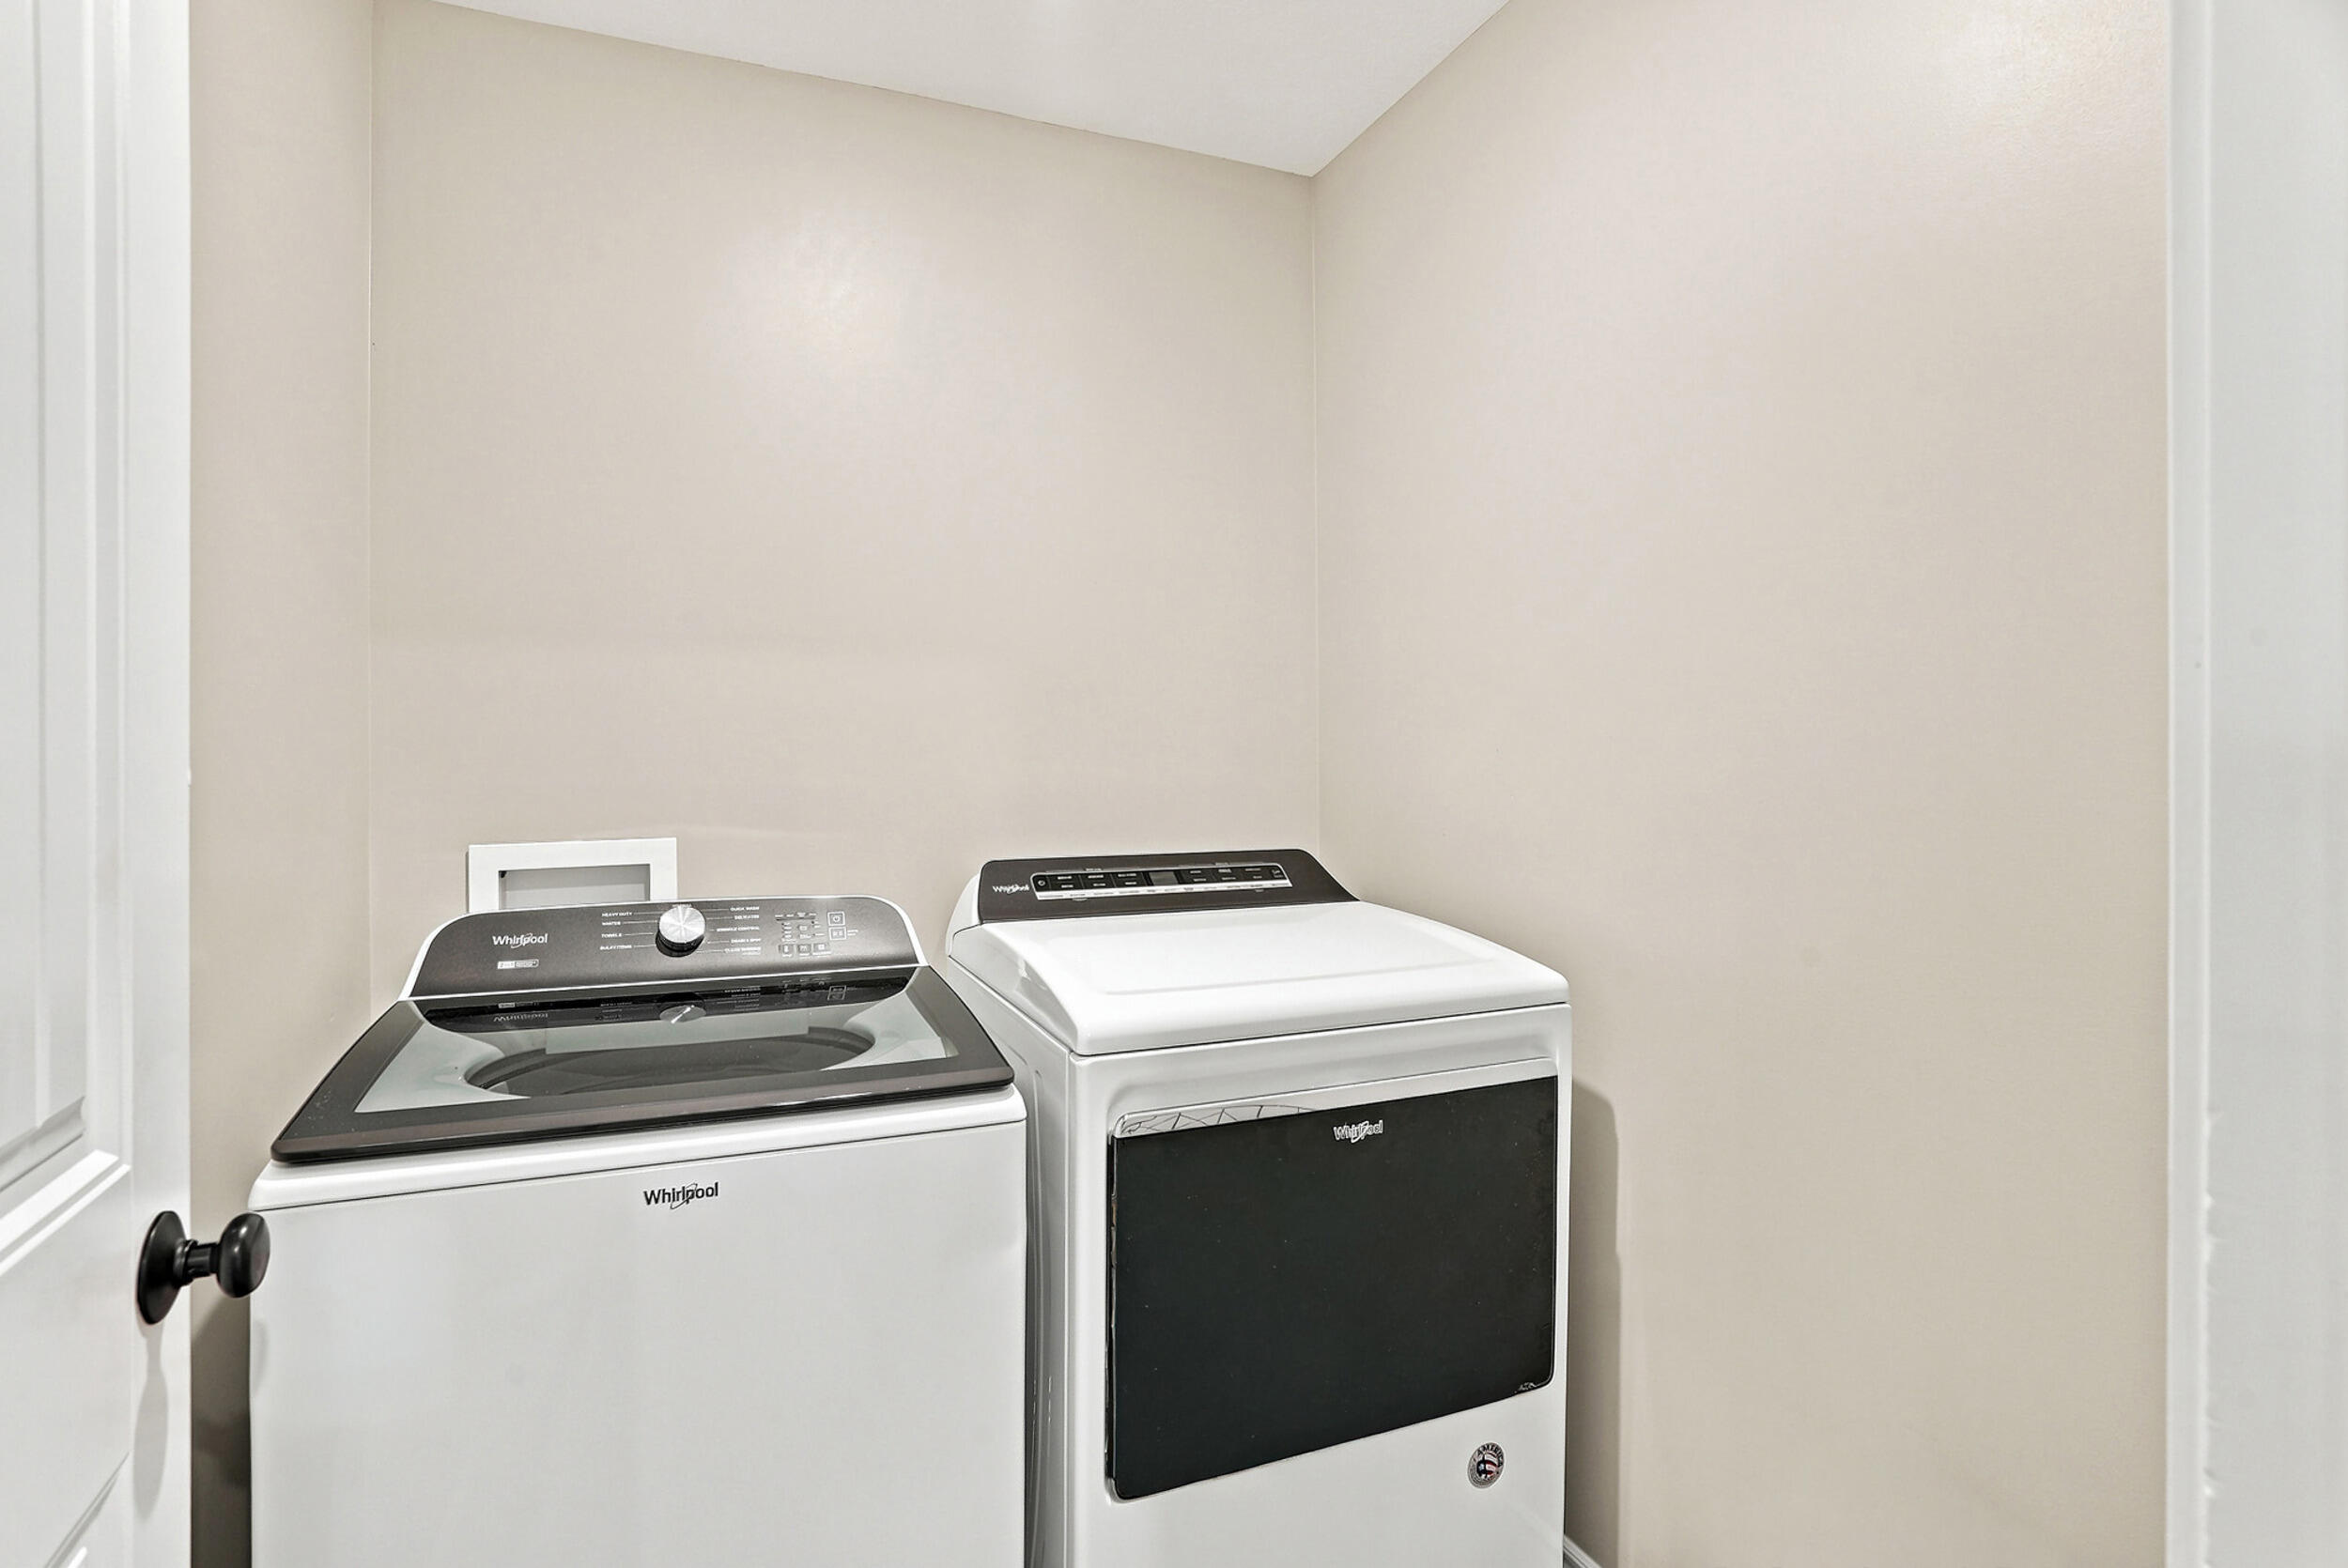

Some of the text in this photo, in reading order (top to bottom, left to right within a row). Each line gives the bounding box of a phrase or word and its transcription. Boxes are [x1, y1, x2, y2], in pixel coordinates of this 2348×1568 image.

[492, 932, 548, 949] Whirlpool
[1334, 1119, 1383, 1143] Whirlpool
[643, 1182, 718, 1209] Whirlpool
